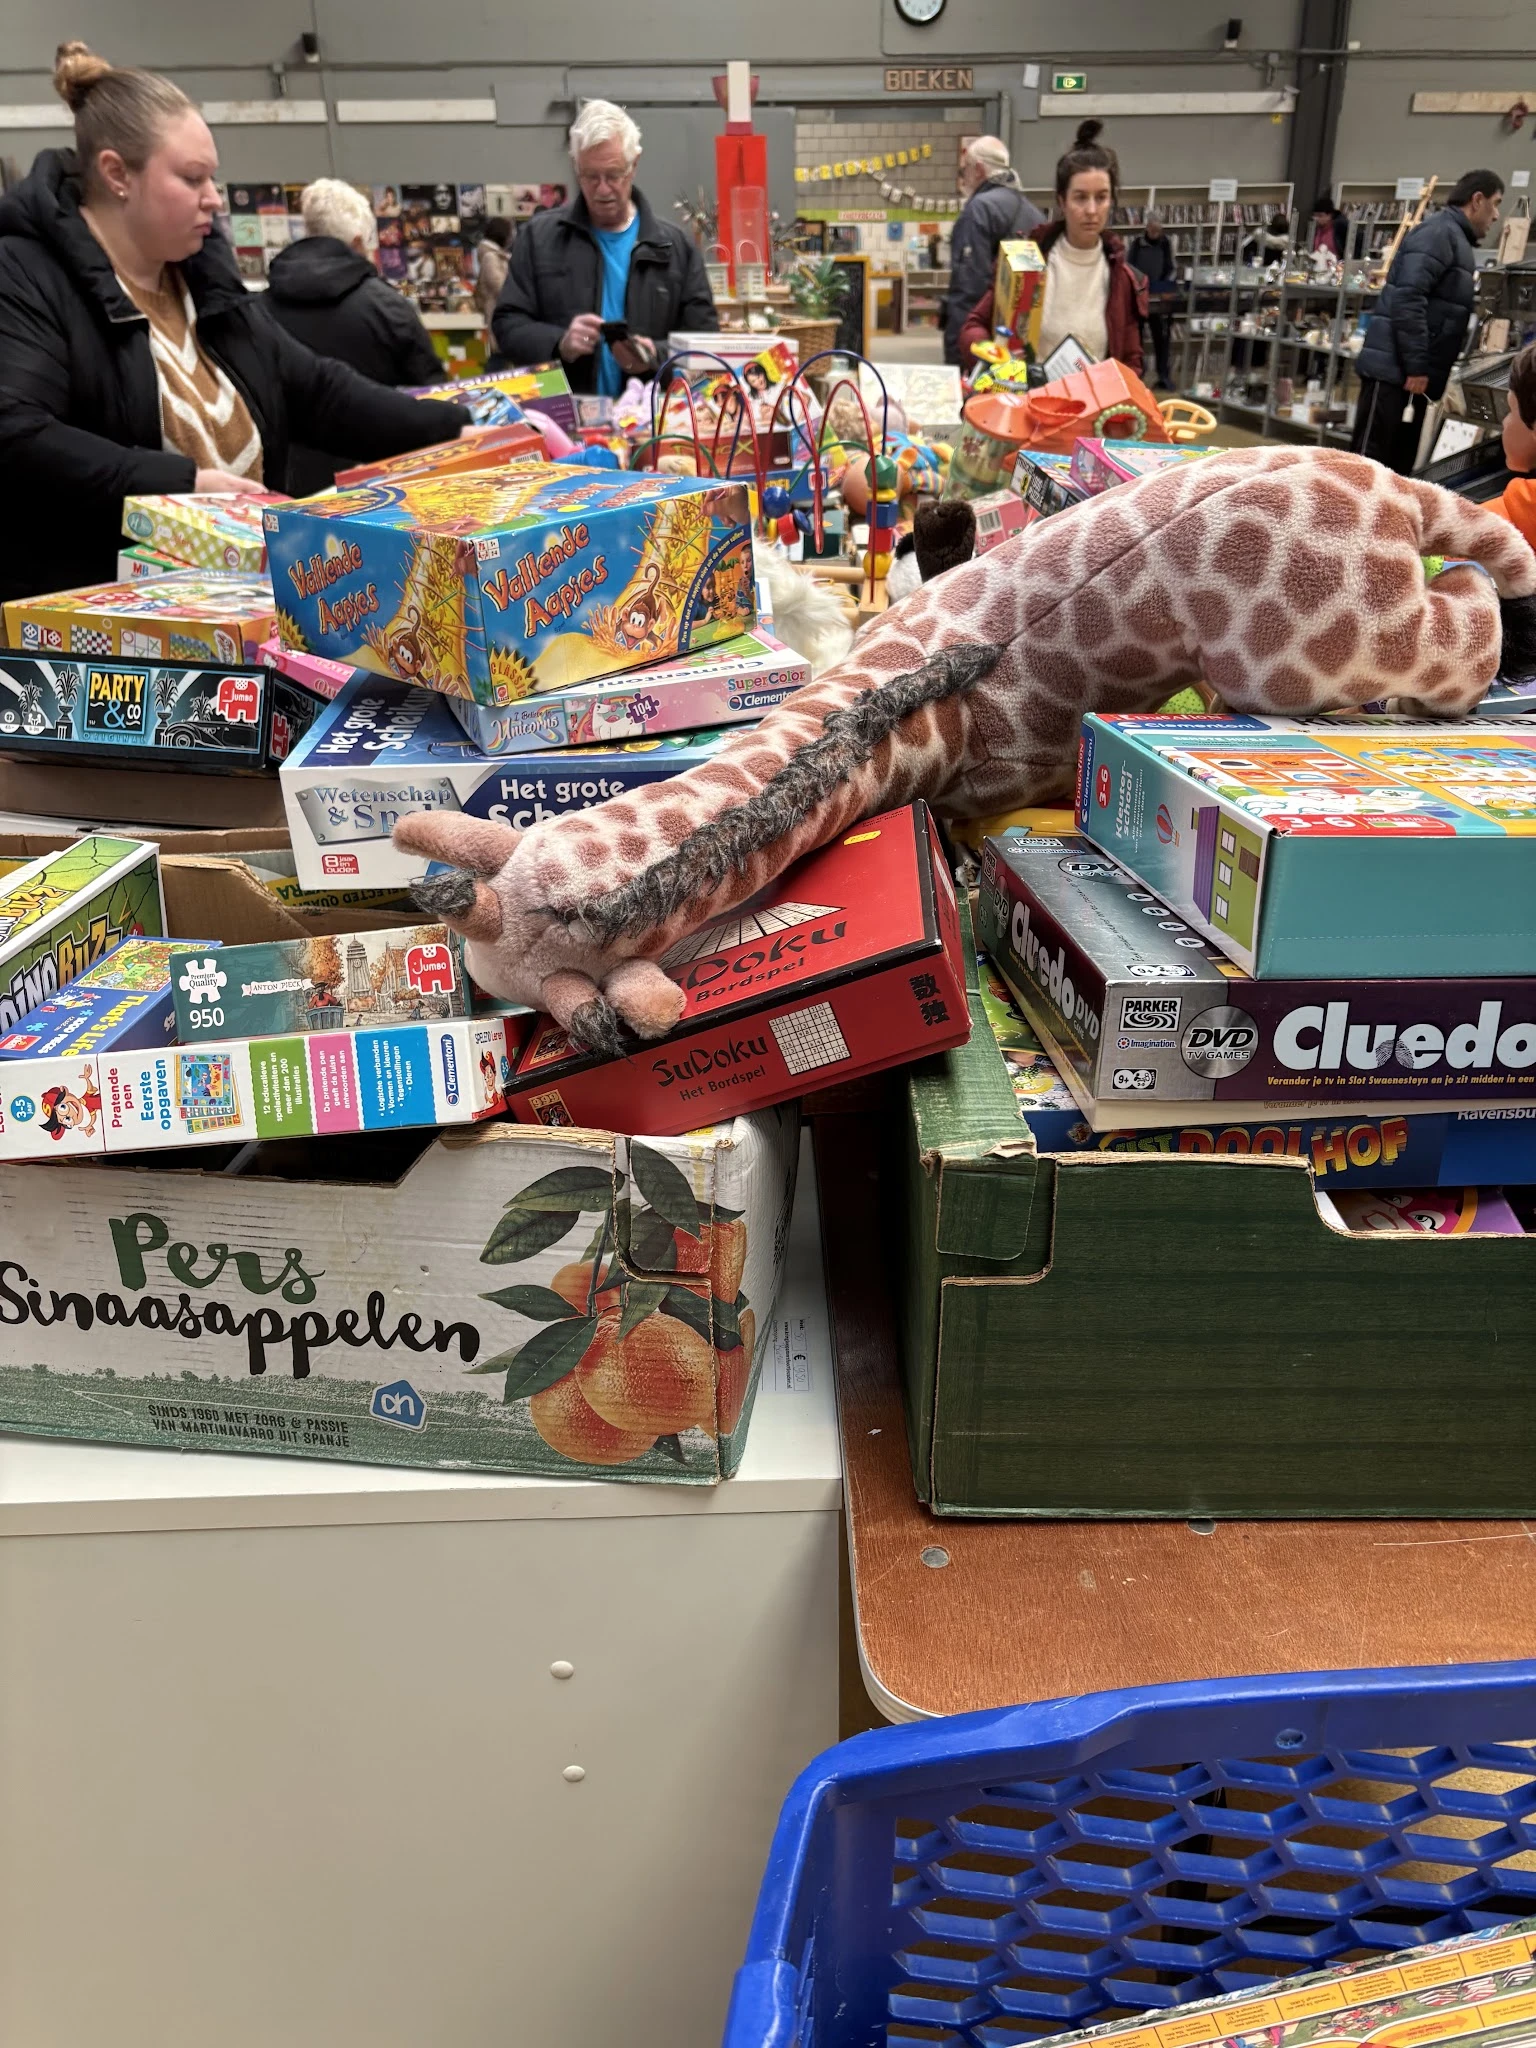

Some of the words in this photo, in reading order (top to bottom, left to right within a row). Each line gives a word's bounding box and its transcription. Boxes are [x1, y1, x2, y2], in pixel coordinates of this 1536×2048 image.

[885, 69, 973, 91] BOEKEN
[133, 562, 149, 577] MB
[288, 540, 363, 600] Vallende
[482, 523, 591, 612] Vallende
[317, 582, 380, 636] Aapjes
[524, 554, 609, 638] Aapjes
[90, 671, 146, 702] PARTY
[491, 661, 527, 698] CLASSIC
[103, 700, 126, 729] &
[127, 704, 142, 720] CO
[632, 701, 653, 716] 104
[83, 732, 149, 746] ORIGINAL
[316, 726, 361, 755] Het
[349, 698, 386, 731] grote
[491, 712, 560, 738] Unicorns
[1083, 737, 1093, 807] Clementoni
[314, 784, 451, 810] Wetenschap
[501, 779, 547, 801] Het
[555, 778, 625, 806] grote
[1098, 769, 1109, 806] 3-6
[1115, 760, 1127, 840] Kleuter-
[327, 805, 349, 826] &
[1124, 771, 1133, 837] school
[1291, 816, 1356, 828] 3-6
[325, 855, 338, 868] 8
[326, 867, 359, 876] ouder
[678, 919, 847, 990] Doku
[188, 978, 218, 989] Quality
[190, 973, 216, 982] Premium
[694, 956, 805, 1003] Bordspel
[1011, 900, 1076, 1021] Cluedo
[1076, 993, 1100, 1041] DVD
[253, 983, 278, 992] ANTON
[280, 980, 301, 990] PIECK
[91, 994, 149, 1037] That's
[189, 1007, 225, 1029] 950
[1124, 1000, 1178, 1013] PARKER
[64, 1017, 88, 1034] 1000
[1187, 1027, 1254, 1049] DVD
[1273, 1001, 1536, 1070] Cluedo
[61, 1031, 100, 1056] Life
[271, 1052, 276, 1063] en
[1187, 1051, 1204, 1060] TV
[1207, 1051, 1250, 1060] GAMES
[329, 1054, 337, 1079] juiste
[394, 1045, 404, 1102] Tegenstellingen
[404, 1060, 412, 1085] Dieren
[445, 1036, 456, 1094] Clementoni
[651, 1035, 770, 1088] SuDoku
[260, 1060, 268, 1103] educatieve
[283, 1080, 291, 1096] dan
[321, 1066, 330, 1102] pratende
[330, 1081, 337, 1091] de
[341, 1064, 350, 1110] antwoorden
[384, 1072, 390, 1080] en
[679, 1082, 705, 1102] Het
[709, 1065, 766, 1094] Bordspel
[1118, 1075, 1129, 1086] 9+
[1267, 1076, 1310, 1086] Verander
[1312, 1077, 1323, 1088] je
[1324, 1076, 1335, 1085] tv
[1336, 1076, 1346, 1085] in
[1348, 1075, 1366, 1085] Slot
[1431, 1076, 1442, 1085] en
[1444, 1076, 1453, 1087] je
[1455, 1075, 1468, 1084] zit
[1470, 1074, 1504, 1084] midden
[1506, 1074, 1516, 1083] in
[1517, 1075, 1535, 1083] een
[107, 1067, 123, 1129] Pratende
[123, 1084, 134, 1109] pen
[140, 1070, 155, 1122] Eerste
[156, 1059, 171, 1130] opgaven
[272, 1065, 283, 1122] spelactiviteiten
[332, 1094, 340, 1113] geeft
[376, 1079, 385, 1113] Logische
[386, 1081, 394, 1109] Vormen
[16, 1098, 26, 1119] 3-5
[263, 1104, 270, 1115] 12
[323, 1103, 330, 1113] De
[109, 1212, 326, 1304] Pers
[0, 1260, 481, 1379] Sinaasappelen
[148, 1404, 188, 1419] SINDS
[191, 1408, 220, 1422] 1960
[224, 1410, 250, 1424] MET
[255, 1413, 286, 1428] ZORG
[290, 1416, 301, 1429] &
[307, 1418, 349, 1433] PASSIE
[152, 1418, 178, 1432] VAN
[181, 1420, 275, 1442] MARTINAVARRO
[279, 1430, 299, 1443] UIT
[303, 1432, 351, 1447] SPANJE
